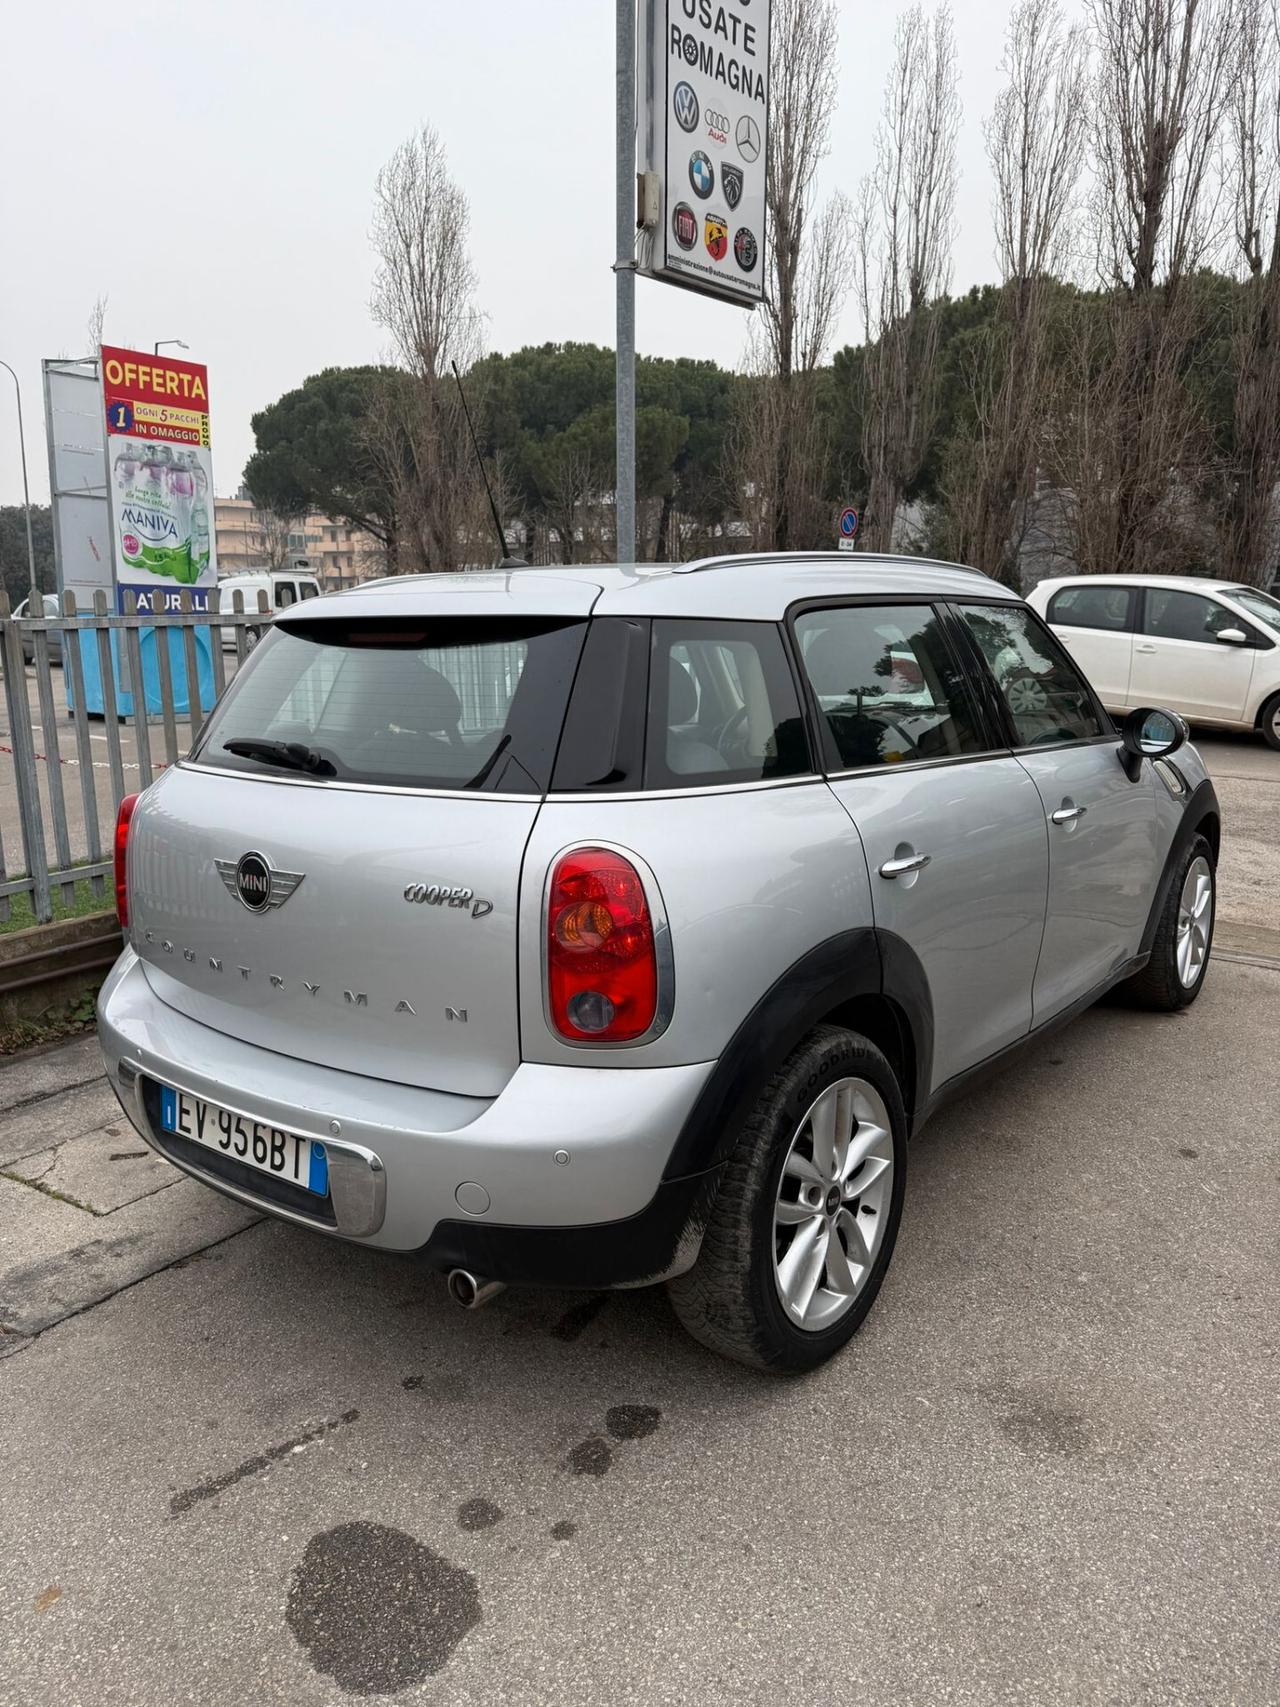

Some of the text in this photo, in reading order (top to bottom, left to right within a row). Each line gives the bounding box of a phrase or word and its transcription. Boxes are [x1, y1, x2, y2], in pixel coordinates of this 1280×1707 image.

[682, 0, 756, 56] USATE
[671, 23, 765, 104] ROMAGNA
[708, 128, 727, 144] Audi
[105, 359, 206, 400] OFFERTA
[116, 406, 126, 427] 1
[135, 406, 199, 424] OGNI 5 PACCHI
[135, 423, 199, 441] IN OMAGGIO
[121, 508, 178, 538] MANIVA
[240, 872, 266, 892] MINI
[404, 883, 493, 919] COOPER D
[145, 931, 468, 1022] COUNTRYMAN
[179, 1092, 206, 1140] EV
[218, 1110, 306, 1179] 956BT
